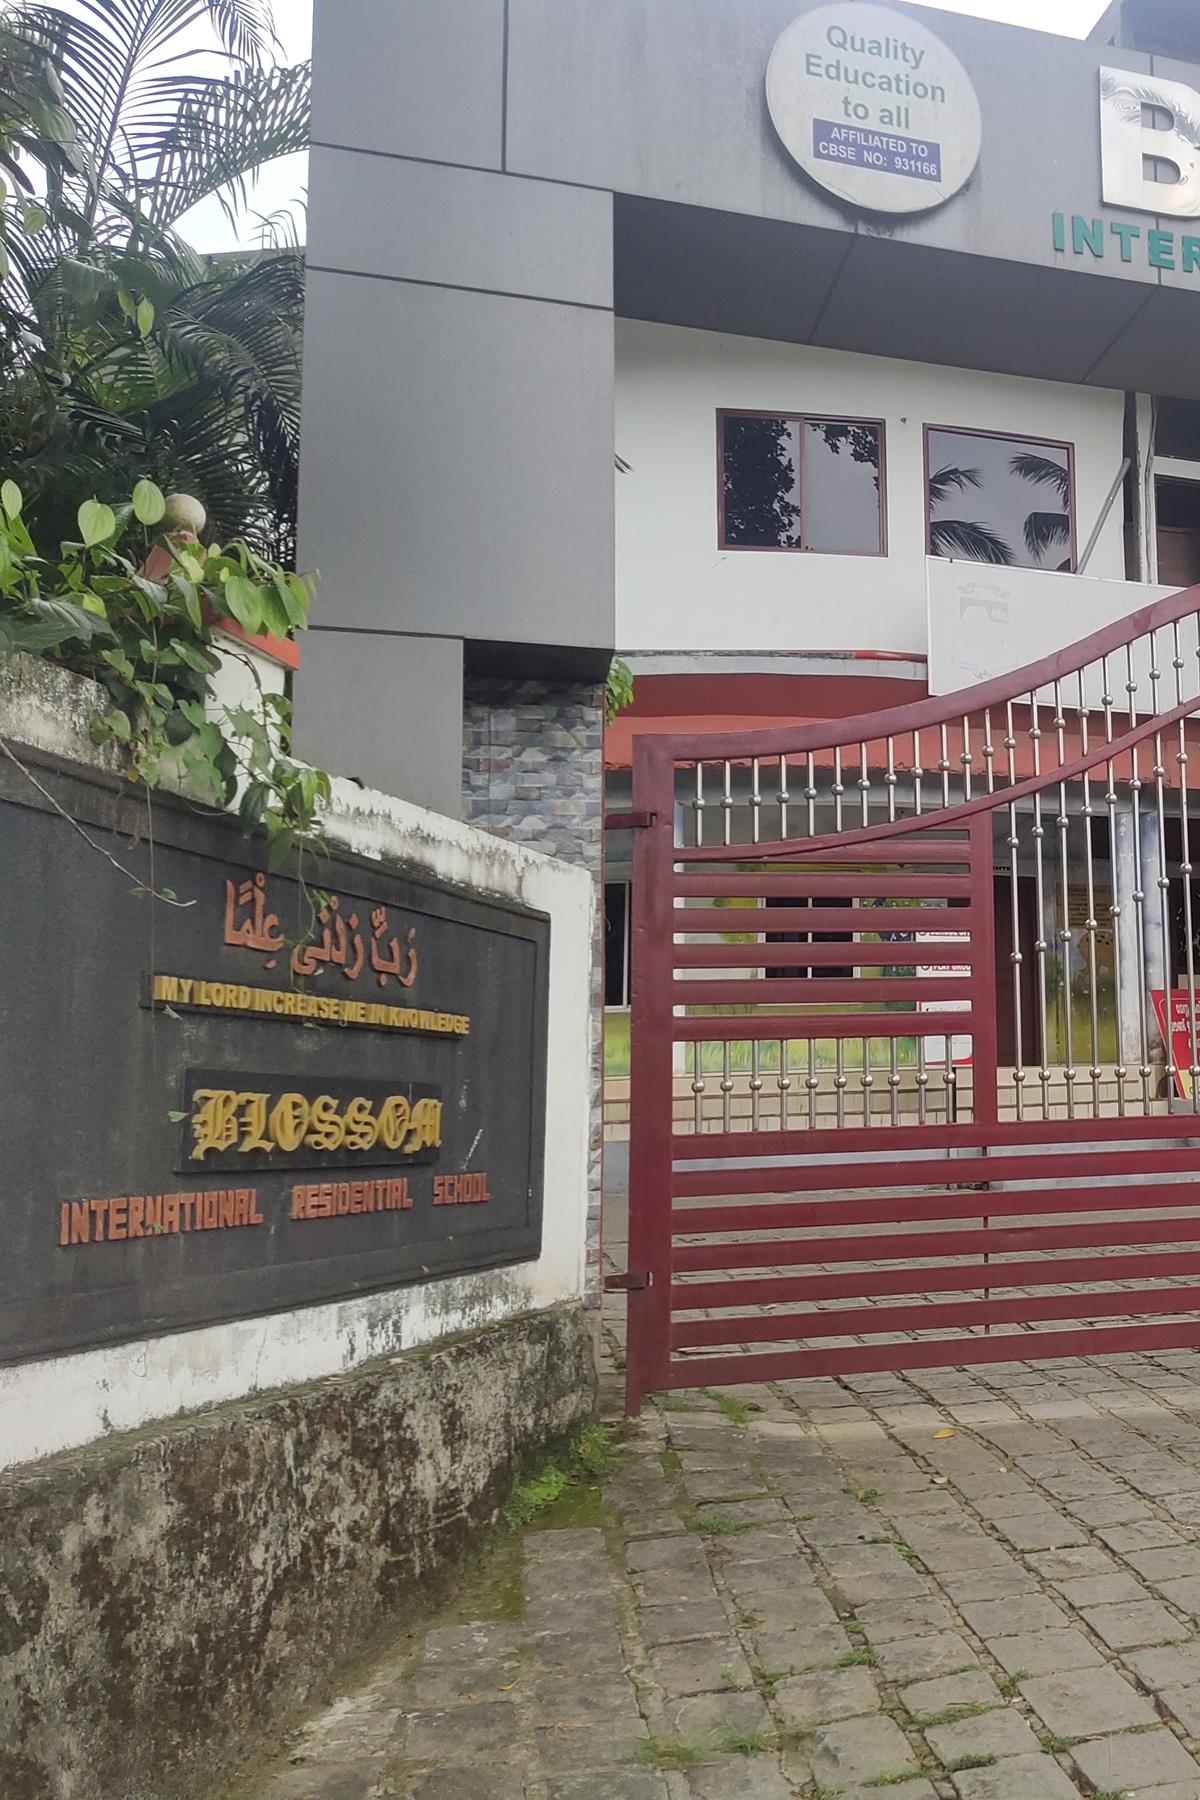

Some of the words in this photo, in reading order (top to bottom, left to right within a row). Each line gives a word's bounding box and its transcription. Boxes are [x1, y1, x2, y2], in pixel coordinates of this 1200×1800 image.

[826, 25, 925, 70] Quality
[804, 53, 945, 103] Education
[842, 95, 869, 120] to
[879, 105, 910, 129] all
[819, 141, 856, 160] CBSE
[863, 152, 887, 167] NO:
[894, 156, 937, 176] 931166
[830, 127, 906, 153] AFFILIATED
[909, 142, 928, 157] TO
[154, 975, 193, 1003] MY
[195, 981, 250, 1009] LORD
[251, 988, 340, 1019] INCREASE
[343, 1000, 367, 1021] ME
[368, 1003, 386, 1024] IN
[387, 1005, 471, 1034] KNOWLEDGE
[60, 1188, 264, 1246] INTERNATIONAL
[288, 1177, 415, 1221] RESIDENTIAL
[432, 1172, 492, 1206] SCHOOL
